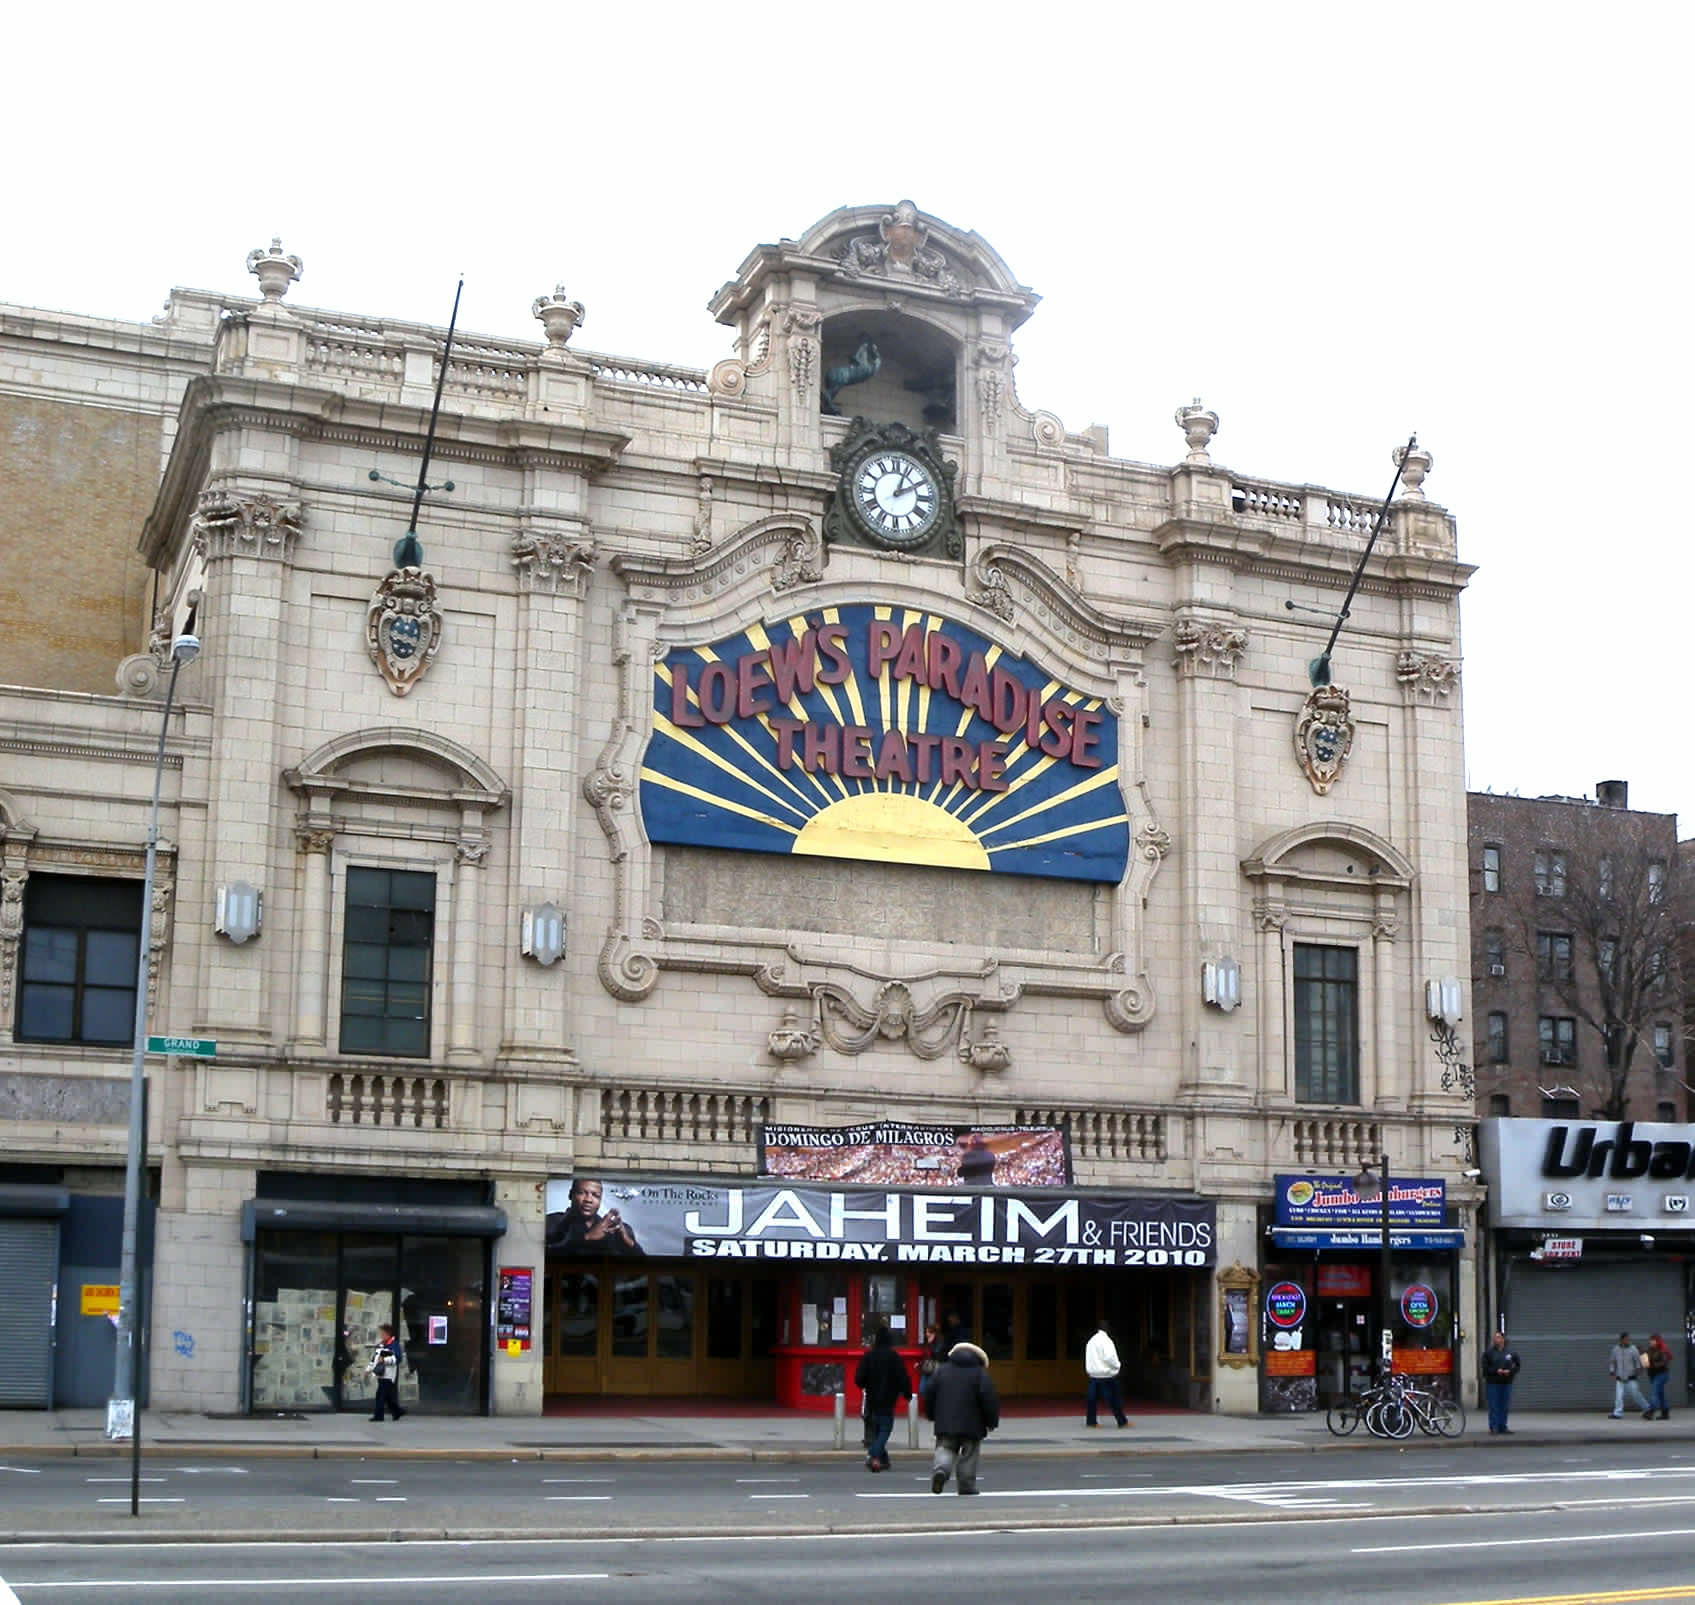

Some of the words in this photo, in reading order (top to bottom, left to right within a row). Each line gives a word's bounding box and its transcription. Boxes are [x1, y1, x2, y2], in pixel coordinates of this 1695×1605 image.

[868, 619, 1105, 768] PARADISE
[768, 717, 1011, 792] THEATRE
[163, 1038, 201, 1050] GRAND
[765, 1132, 844, 1146] DOMINGO
[848, 1131, 871, 1145] DE
[875, 1130, 955, 1146] MILAGROS
[1542, 1122, 1695, 1179] Urba
[641, 1188, 660, 1199] On
[663, 1187, 683, 1200] The
[685, 1189, 719, 1201] Rocks
[1312, 1188, 1360, 1208] Jumbo
[684, 1188, 1080, 1245] JAHEIM
[1082, 1220, 1103, 1245] &
[1110, 1221, 1212, 1248] FRIENDS
[1330, 1233, 1360, 1244] Jumbo
[898, 1244, 1026, 1264] MARCH
[1034, 1248, 1116, 1265] 27TH
[1124, 1249, 1207, 1267] 2010
